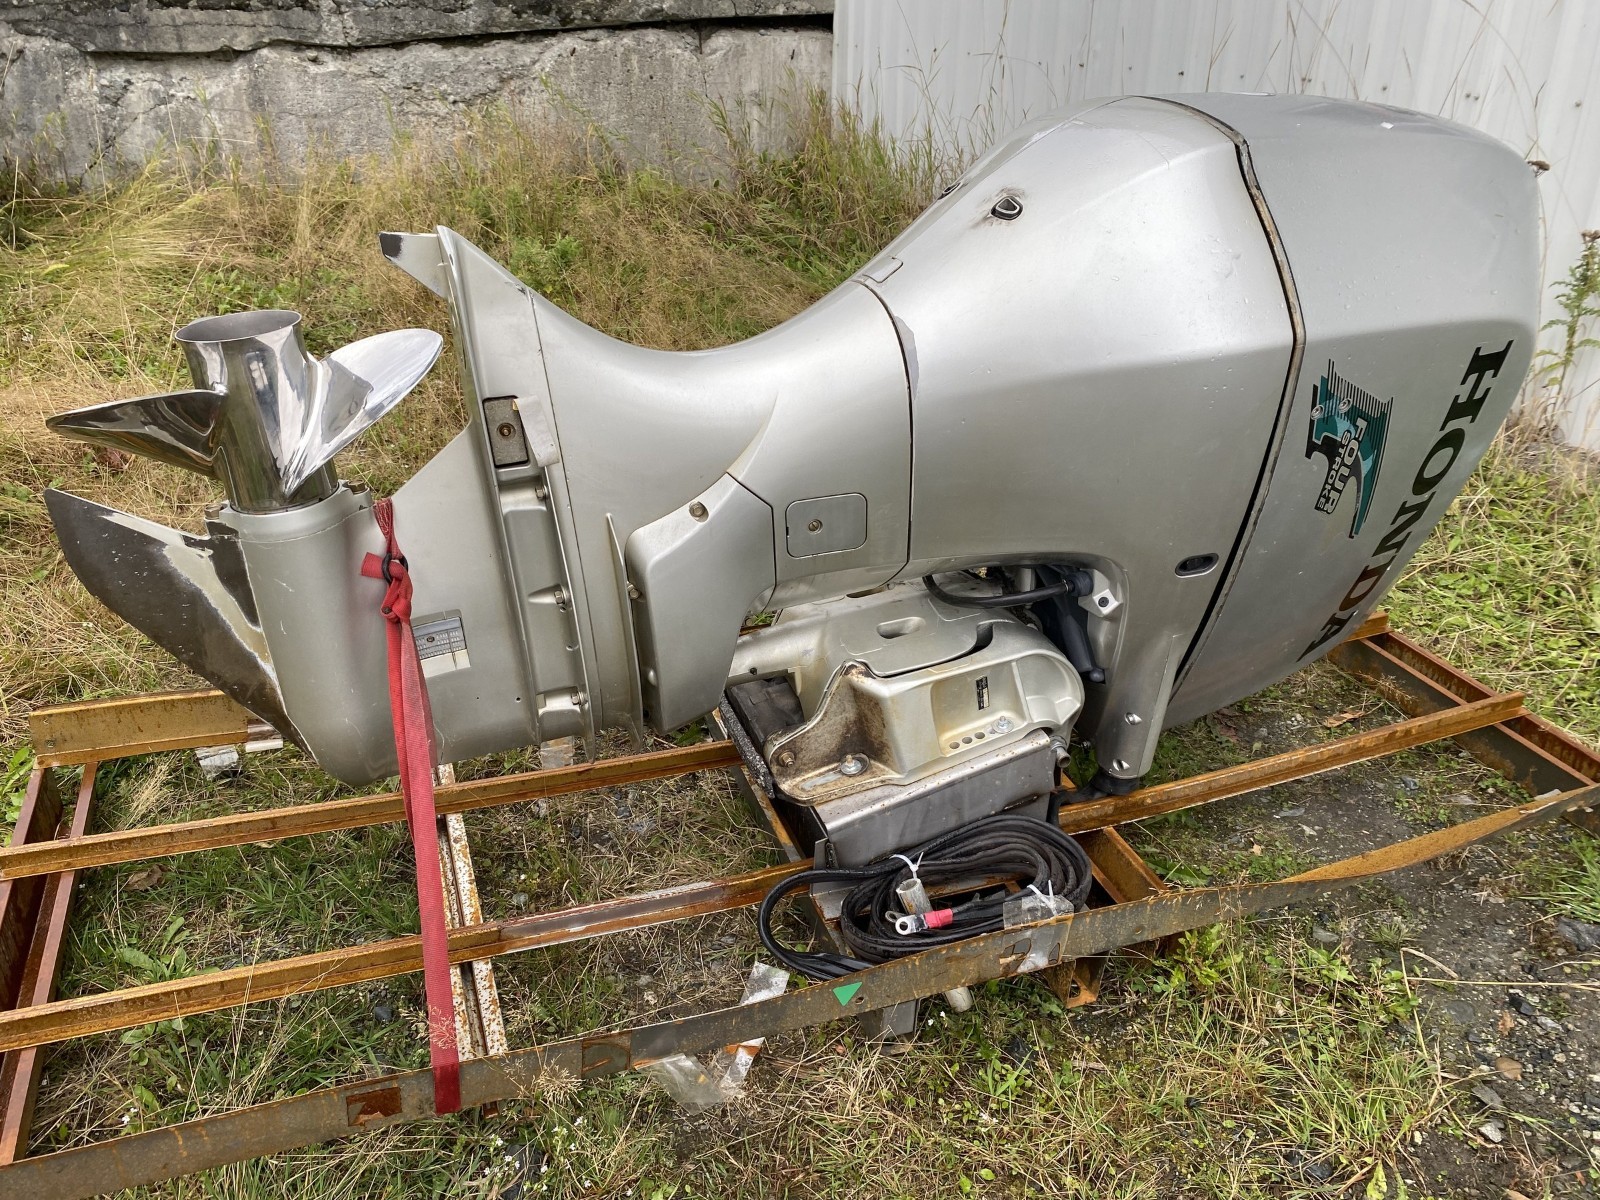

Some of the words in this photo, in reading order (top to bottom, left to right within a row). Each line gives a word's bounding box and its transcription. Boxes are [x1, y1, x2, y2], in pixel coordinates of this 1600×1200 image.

[1297, 339, 1514, 662] HONDA
[1317, 430, 1351, 509] STROKE
[1324, 417, 1368, 513] FOUR
